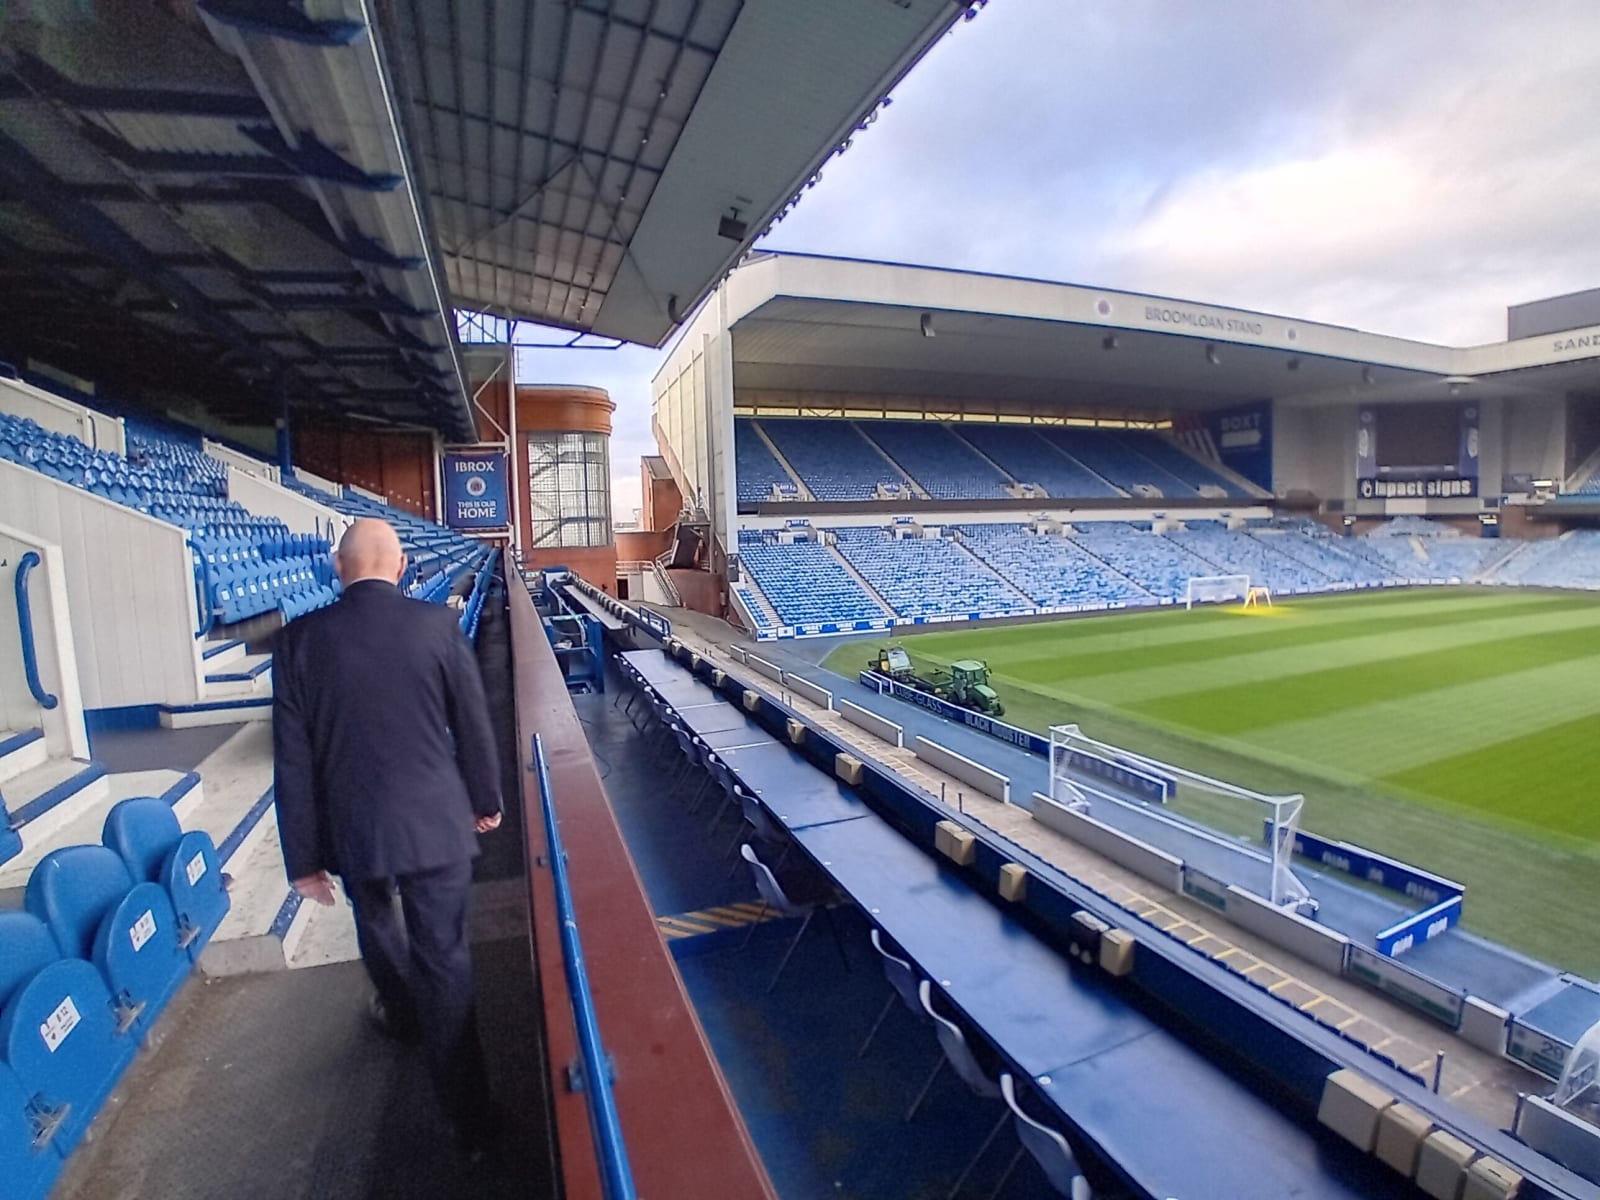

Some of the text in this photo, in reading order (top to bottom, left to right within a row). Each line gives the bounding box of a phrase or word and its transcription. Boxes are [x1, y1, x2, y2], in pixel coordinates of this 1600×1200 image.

[1144, 306, 1263, 336] BROOMLOAN STAND
[455, 461, 495, 472] IBROX
[458, 508, 497, 518] HOME
